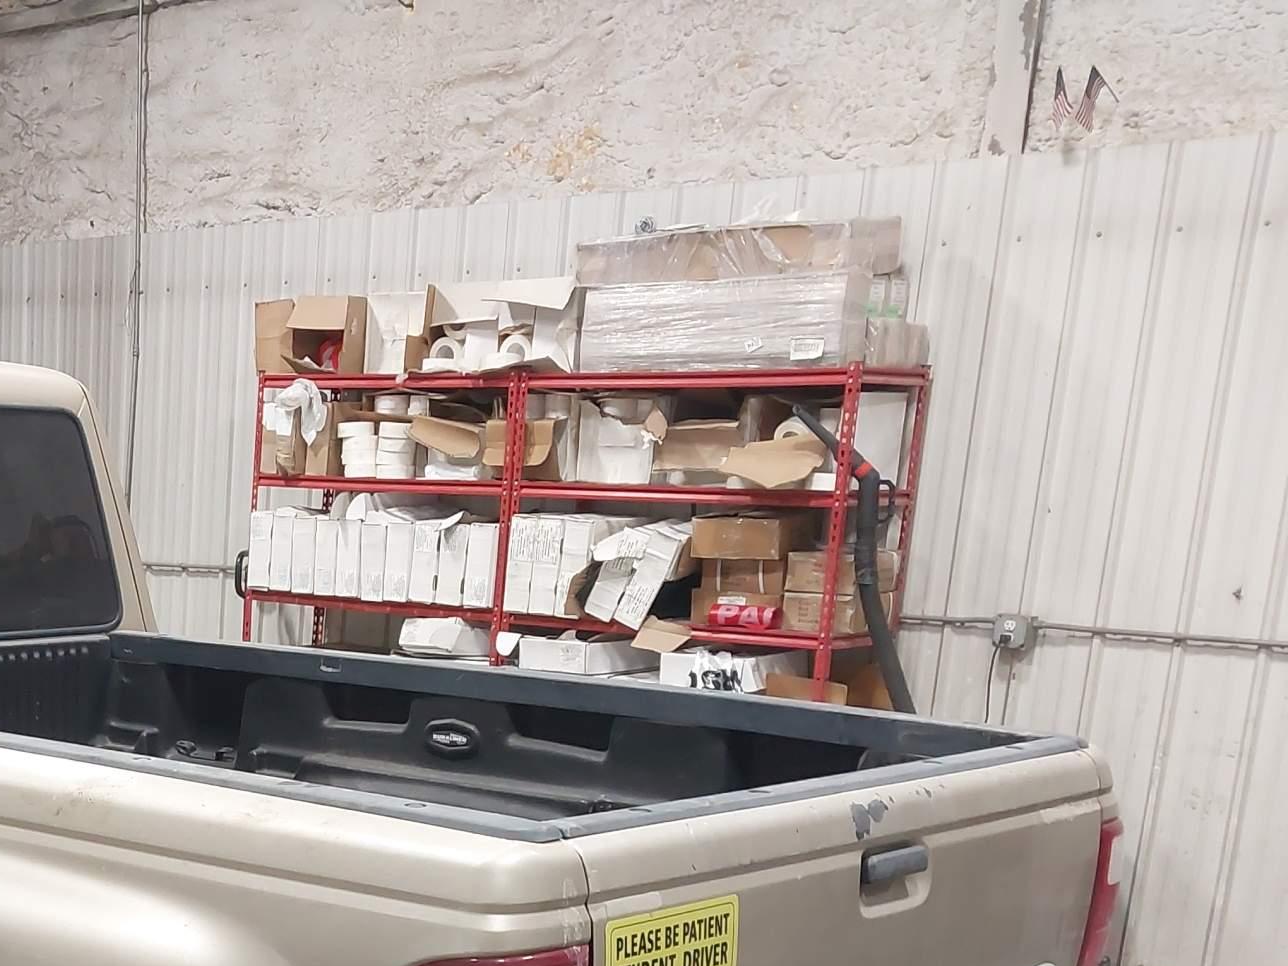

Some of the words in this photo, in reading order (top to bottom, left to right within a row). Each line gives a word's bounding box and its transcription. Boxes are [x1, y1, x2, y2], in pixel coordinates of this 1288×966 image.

[616, 928, 661, 960] PLEASE
[664, 924, 680, 950] BE
[682, 913, 730, 944] PATIENT
